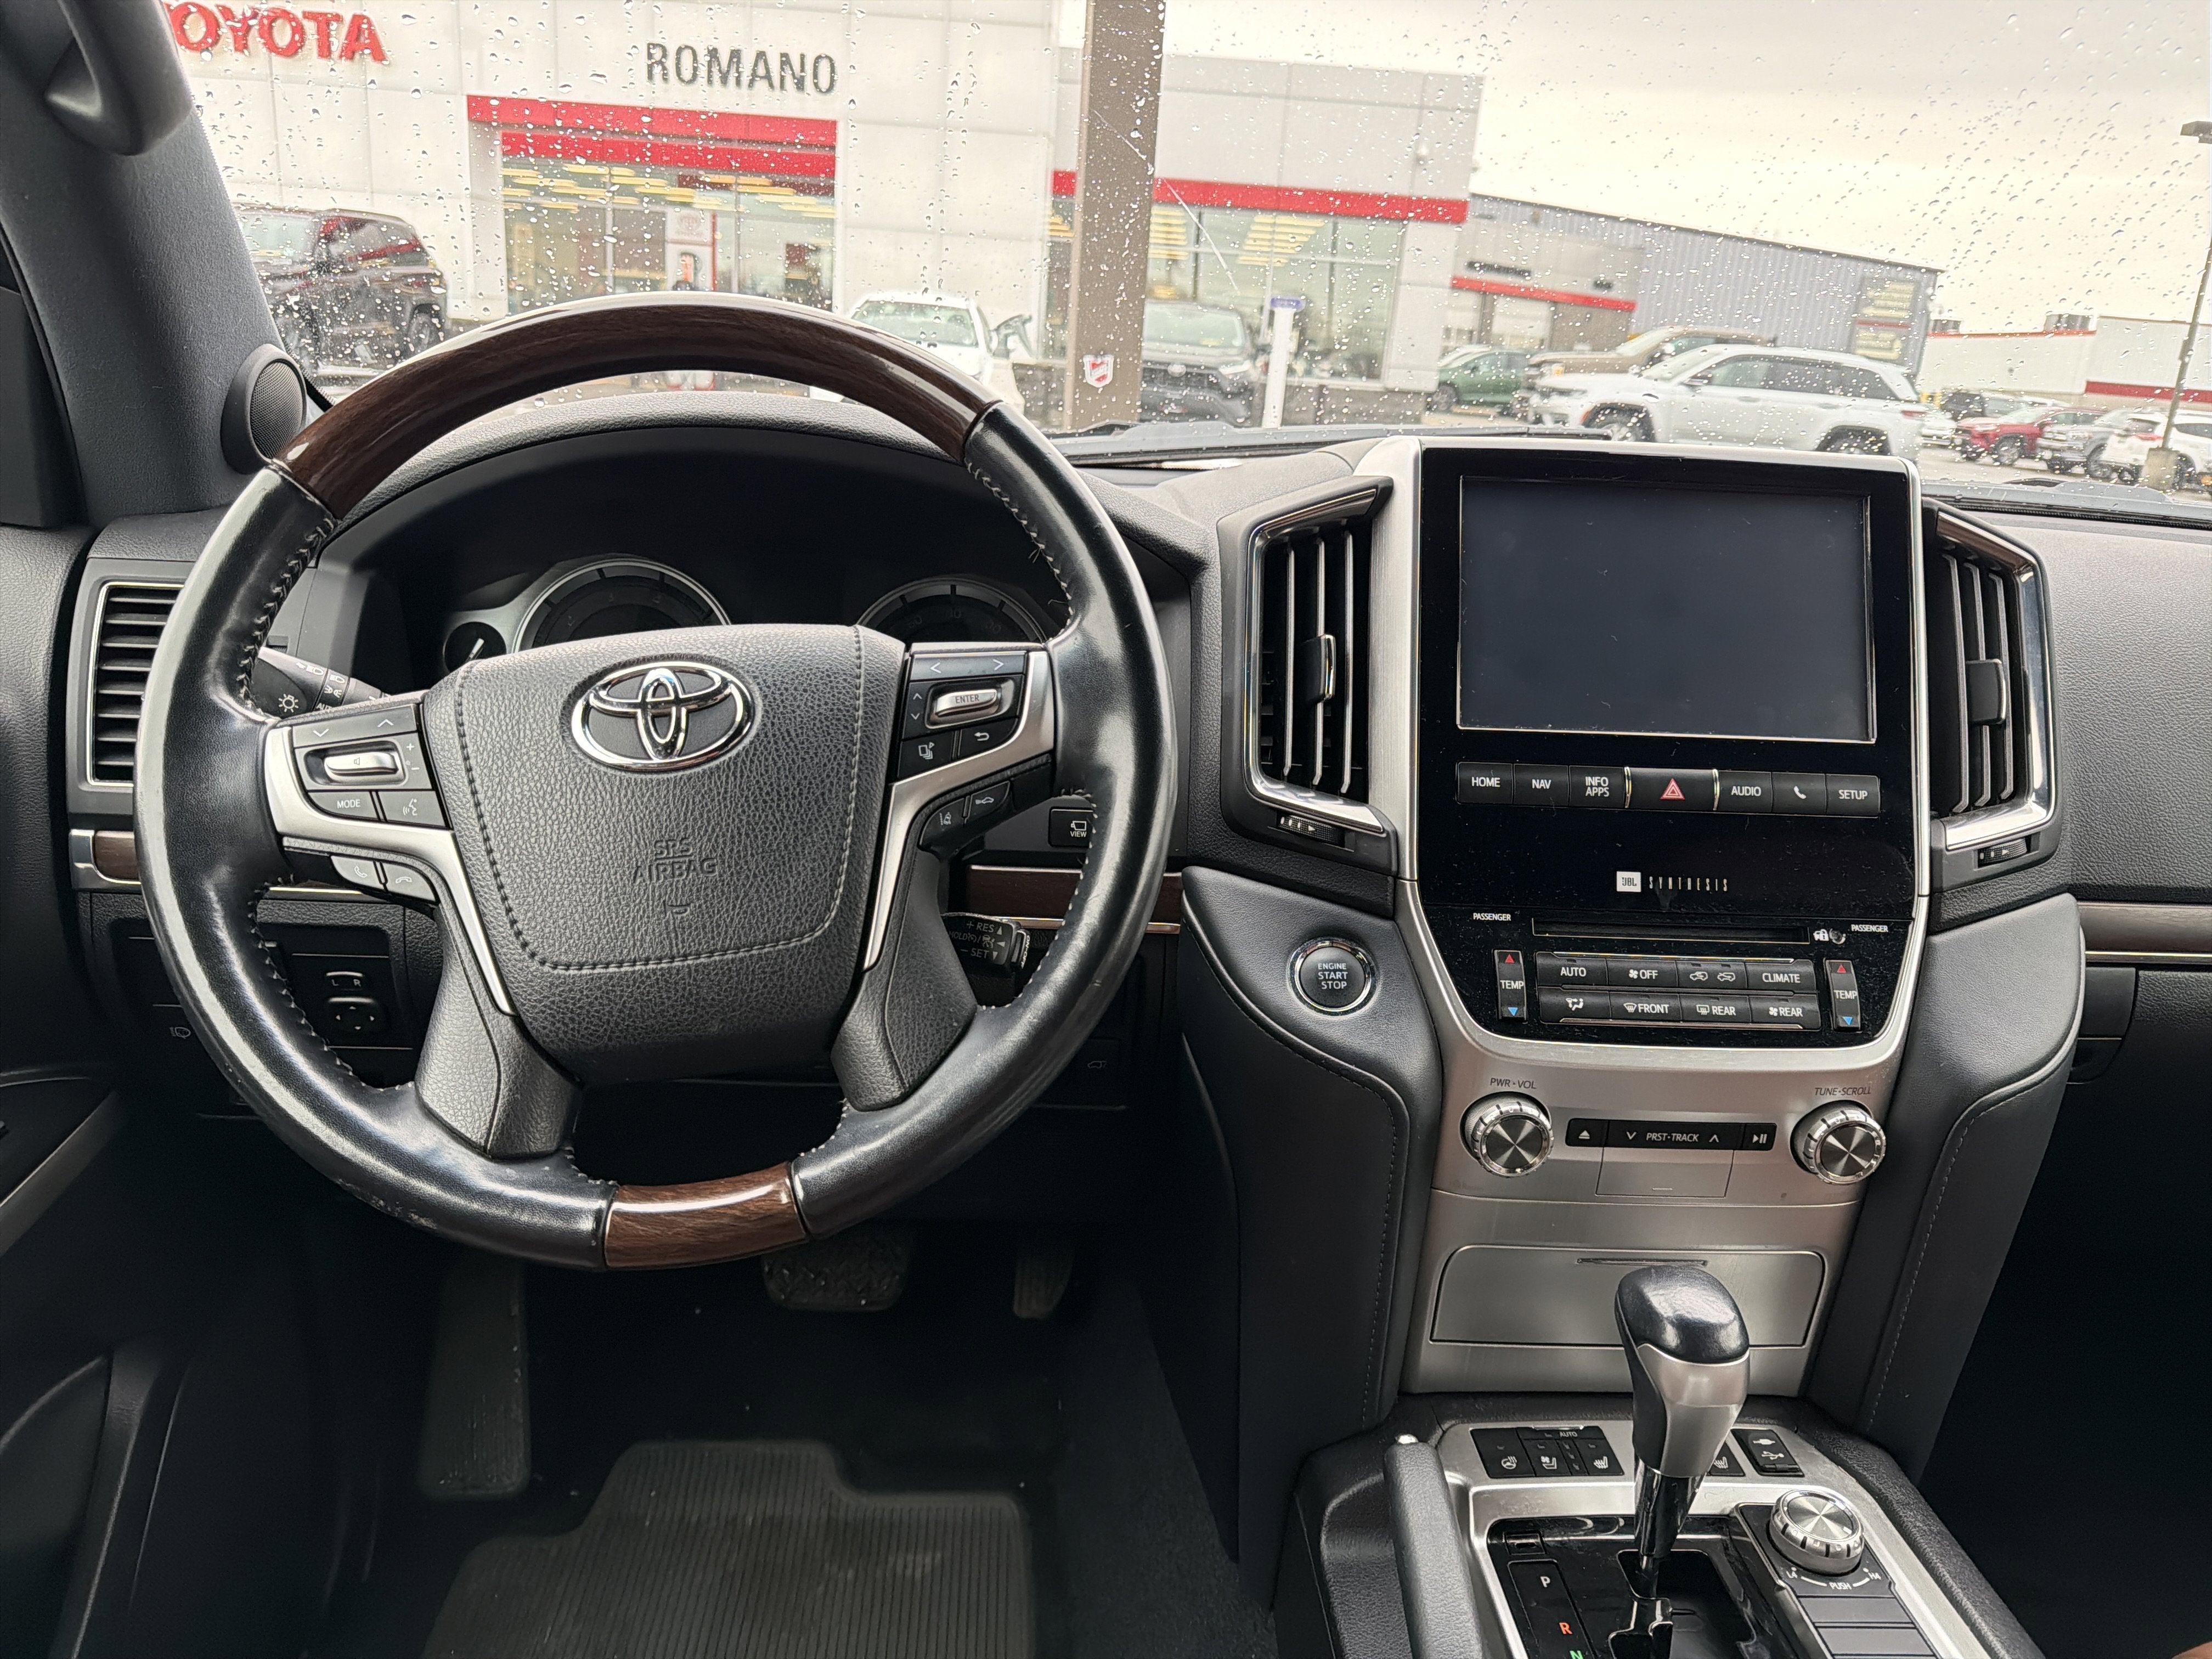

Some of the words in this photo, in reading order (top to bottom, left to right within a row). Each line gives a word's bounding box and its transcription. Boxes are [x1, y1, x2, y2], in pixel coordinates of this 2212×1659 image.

[163, 2, 389, 63] OYOTA
[646, 42, 837, 94] ROMANO
[955, 694, 980, 704] ENTER
[1471, 776, 1500, 788] HOME
[1532, 779, 1551, 789] NAV
[1585, 776, 1609, 787] INFO
[1585, 787, 1610, 797] APPS
[1731, 786, 1762, 797] AUDIO
[1839, 789, 1868, 800] SETUP
[337, 799, 361, 809] MODE
[633, 857, 717, 883] AIRBAG
[1622, 877, 1637, 887] JBL
[1649, 876, 1728, 891] SYNTHESIS
[1473, 913, 1511, 922] PASSENGER
[976, 922, 995, 933] RES
[1851, 924, 1889, 933] PASSENGER
[970, 947, 990, 958] SET
[1318, 971, 1348, 980] START
[1560, 967, 1587, 977] AUTO
[1639, 970, 1658, 980] OFF
[353, 979, 361, 987] R
[1762, 973, 1801, 984] CLIMATE
[1321, 981, 1347, 990] STOP
[1500, 980, 1524, 990] TEMP
[1834, 990, 1857, 1000] TEMP
[1638, 1004, 1669, 1014] FRONT
[1712, 1006, 1737, 1016] REAR
[1779, 1006, 1803, 1017] REAR
[1540, 1576, 1551, 1588] P
[1829, 1581, 1852, 1590] PUSH
[1559, 1622, 1573, 1635] R
[1570, 1650, 1584, 1659] N
